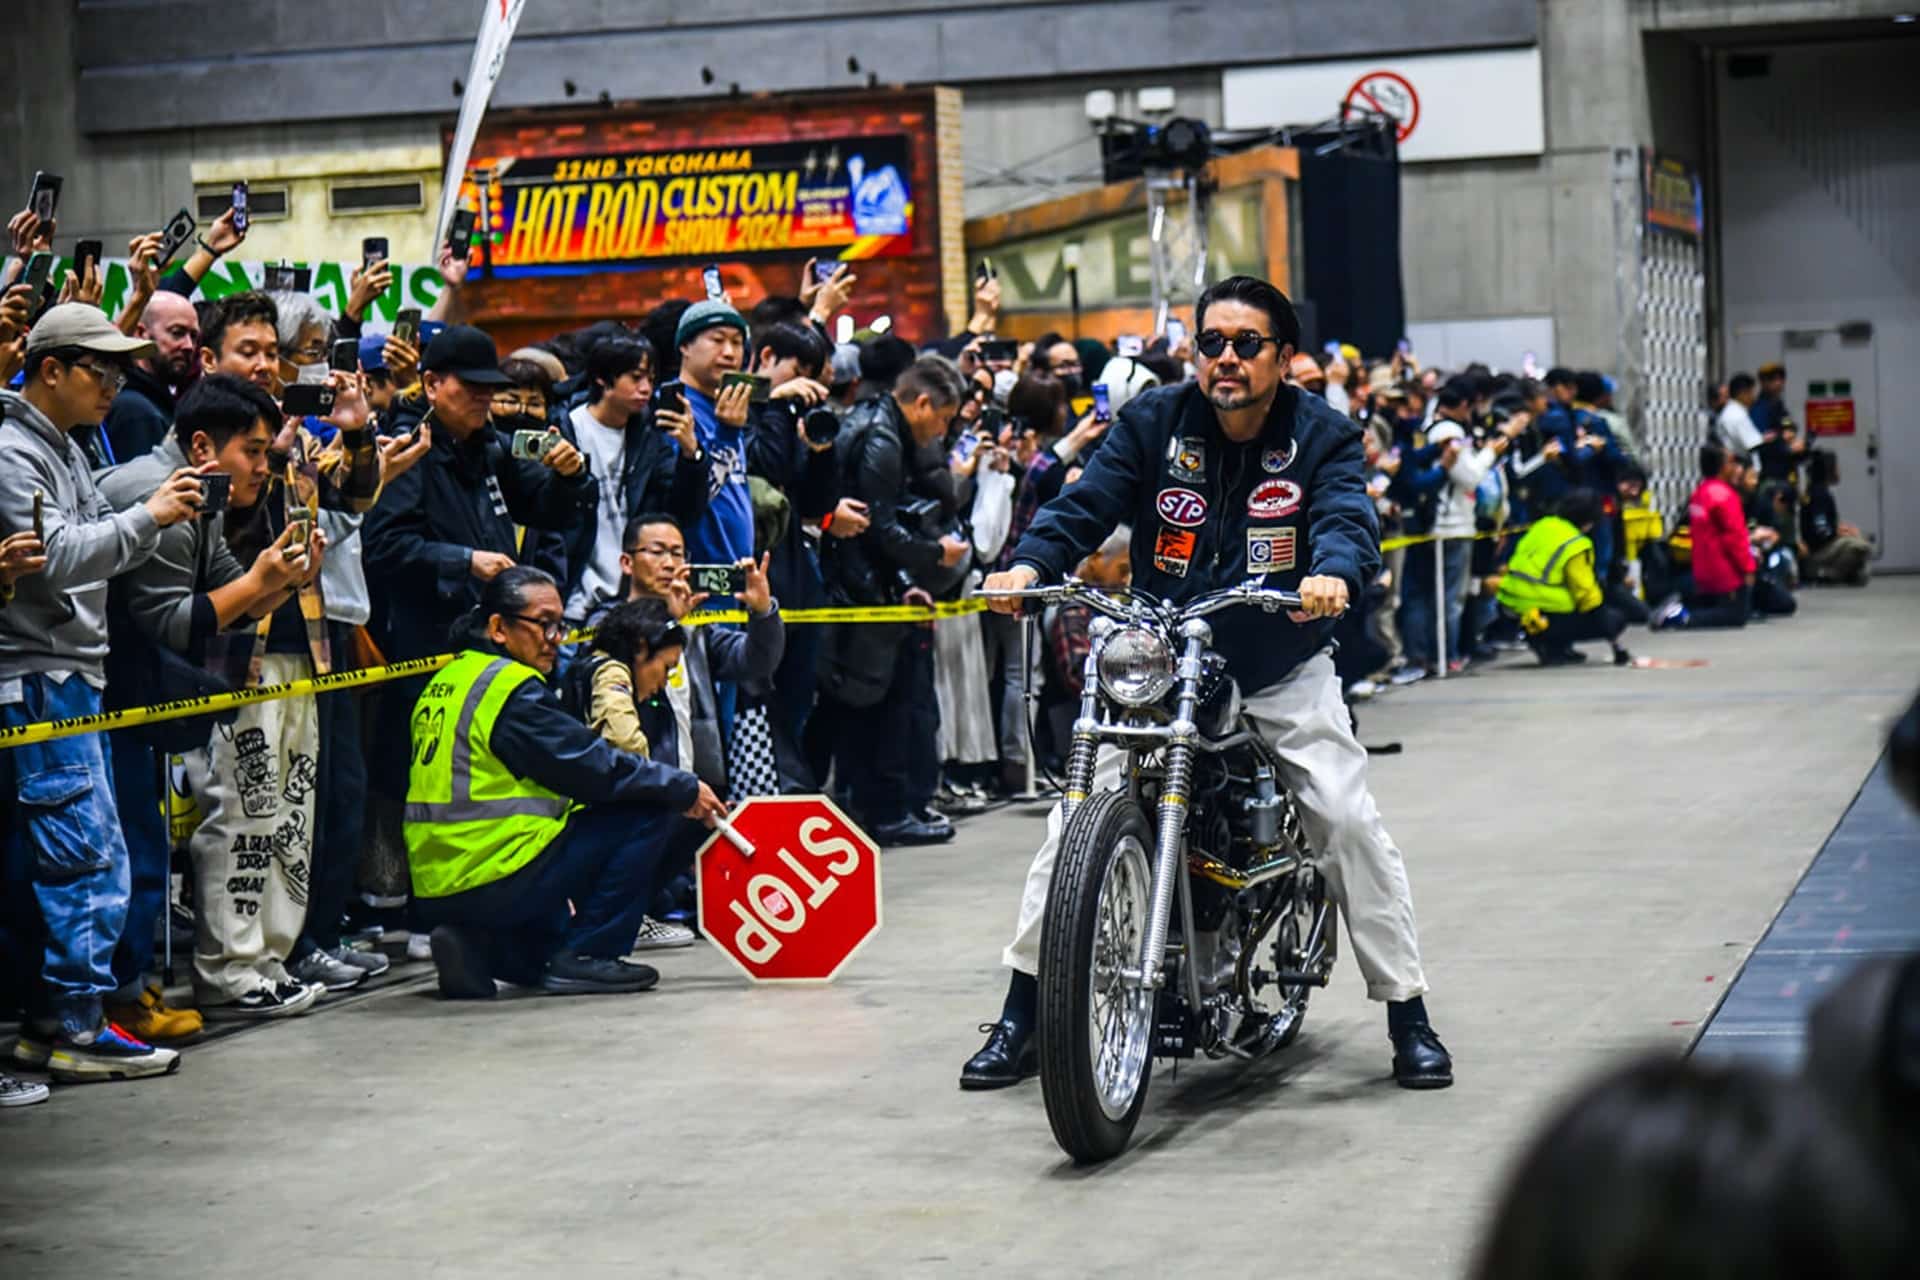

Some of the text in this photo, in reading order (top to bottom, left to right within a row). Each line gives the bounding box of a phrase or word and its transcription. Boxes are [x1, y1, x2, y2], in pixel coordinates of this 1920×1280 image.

[553, 150, 752, 181] 32ND YOKOHAMA
[662, 171, 799, 219] CUSTOM
[507, 180, 659, 265] HOT ROD
[663, 213, 794, 255] SHOW 2024
[1161, 494, 1204, 520] STP
[728, 816, 860, 964] STOP
